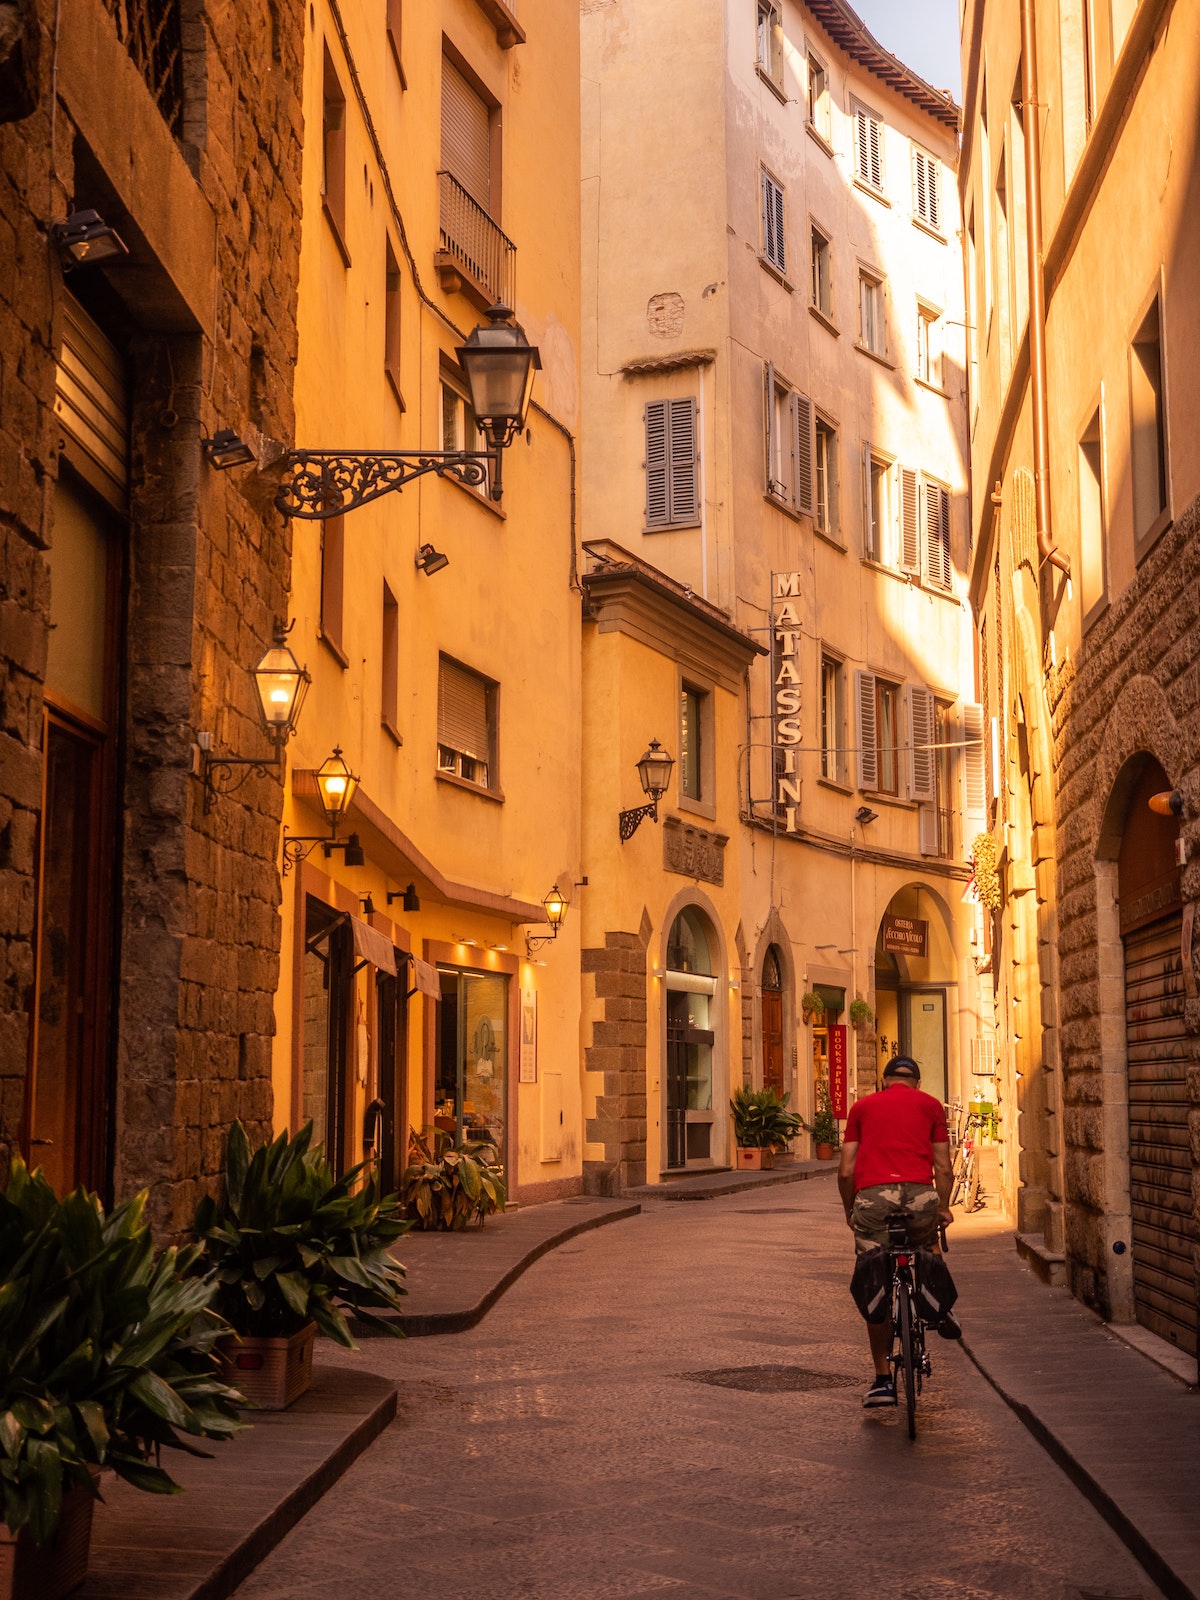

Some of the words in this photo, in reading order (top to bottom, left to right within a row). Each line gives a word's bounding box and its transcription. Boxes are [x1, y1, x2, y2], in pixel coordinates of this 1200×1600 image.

[775, 572, 803, 833] MATASSINI
[886, 927, 905, 940] VECCHIO
[906, 930, 923, 943] VICOLO
[894, 919, 913, 930] OSTERIA
[834, 1030, 842, 1063] BOOKS
[834, 1071, 842, 1112] PRINTS
